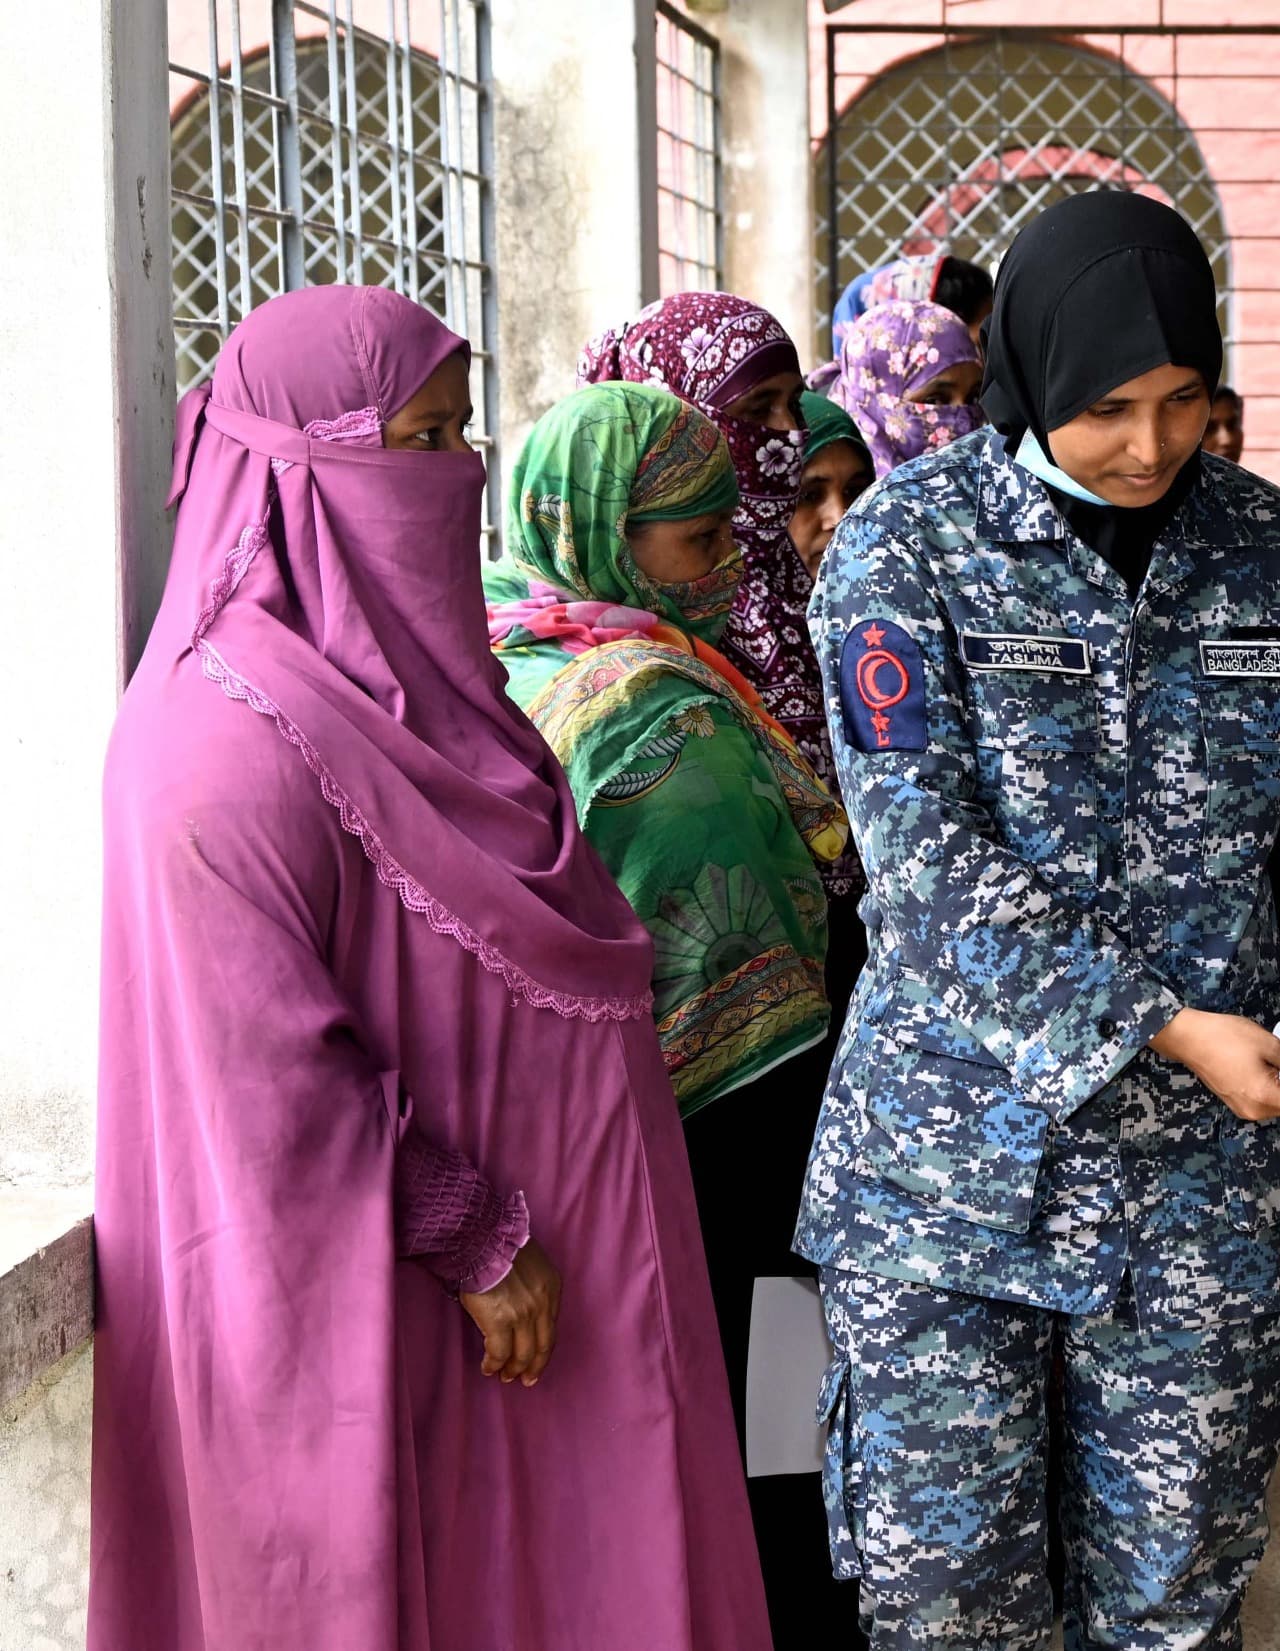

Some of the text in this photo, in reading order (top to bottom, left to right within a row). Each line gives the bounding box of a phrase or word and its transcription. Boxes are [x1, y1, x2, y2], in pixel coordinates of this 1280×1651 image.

[987, 640, 1062, 655] তাসলিমা
[988, 653, 1064, 666] TASLIMA
[1207, 648, 1260, 661] বাংলাদেশ
